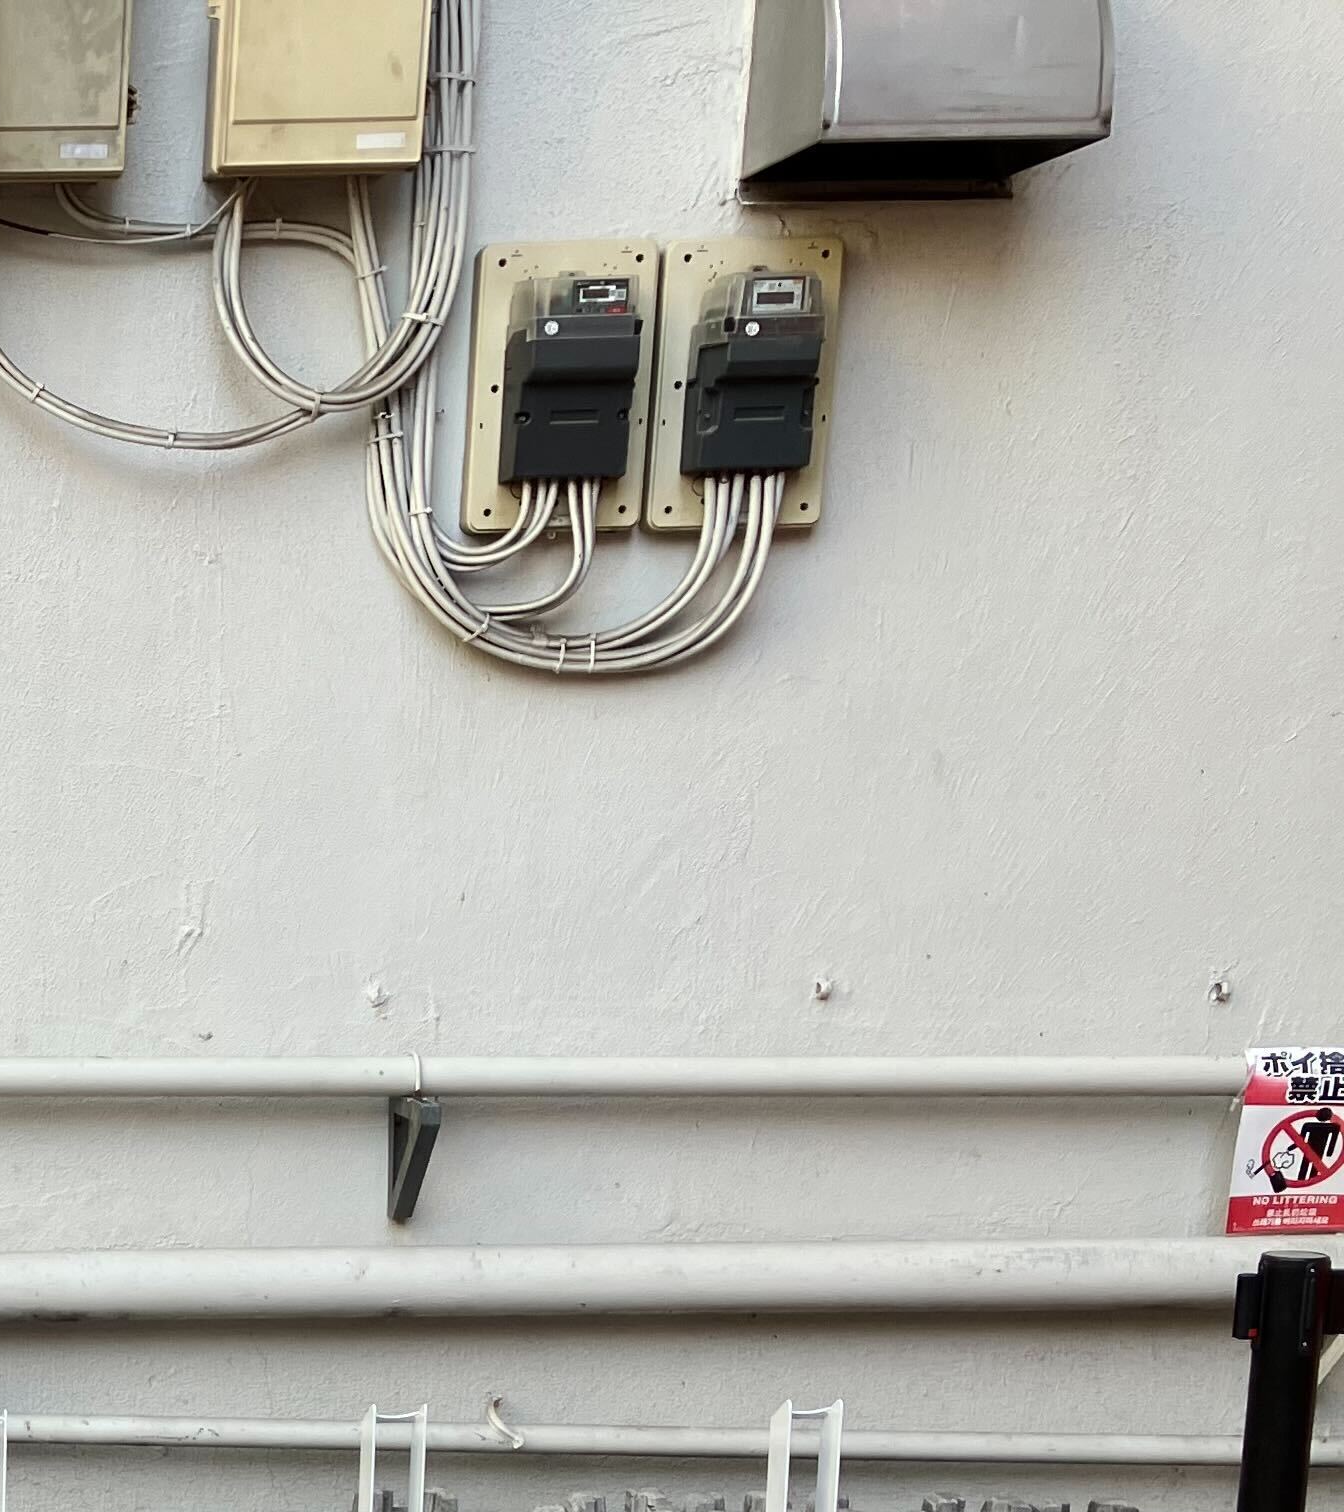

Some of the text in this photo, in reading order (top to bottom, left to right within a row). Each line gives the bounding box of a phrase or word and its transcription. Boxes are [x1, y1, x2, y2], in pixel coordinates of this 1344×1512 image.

[1288, 1076, 1344, 1102] 禁止
[1252, 1195, 1338, 1206] NO LITTERING
